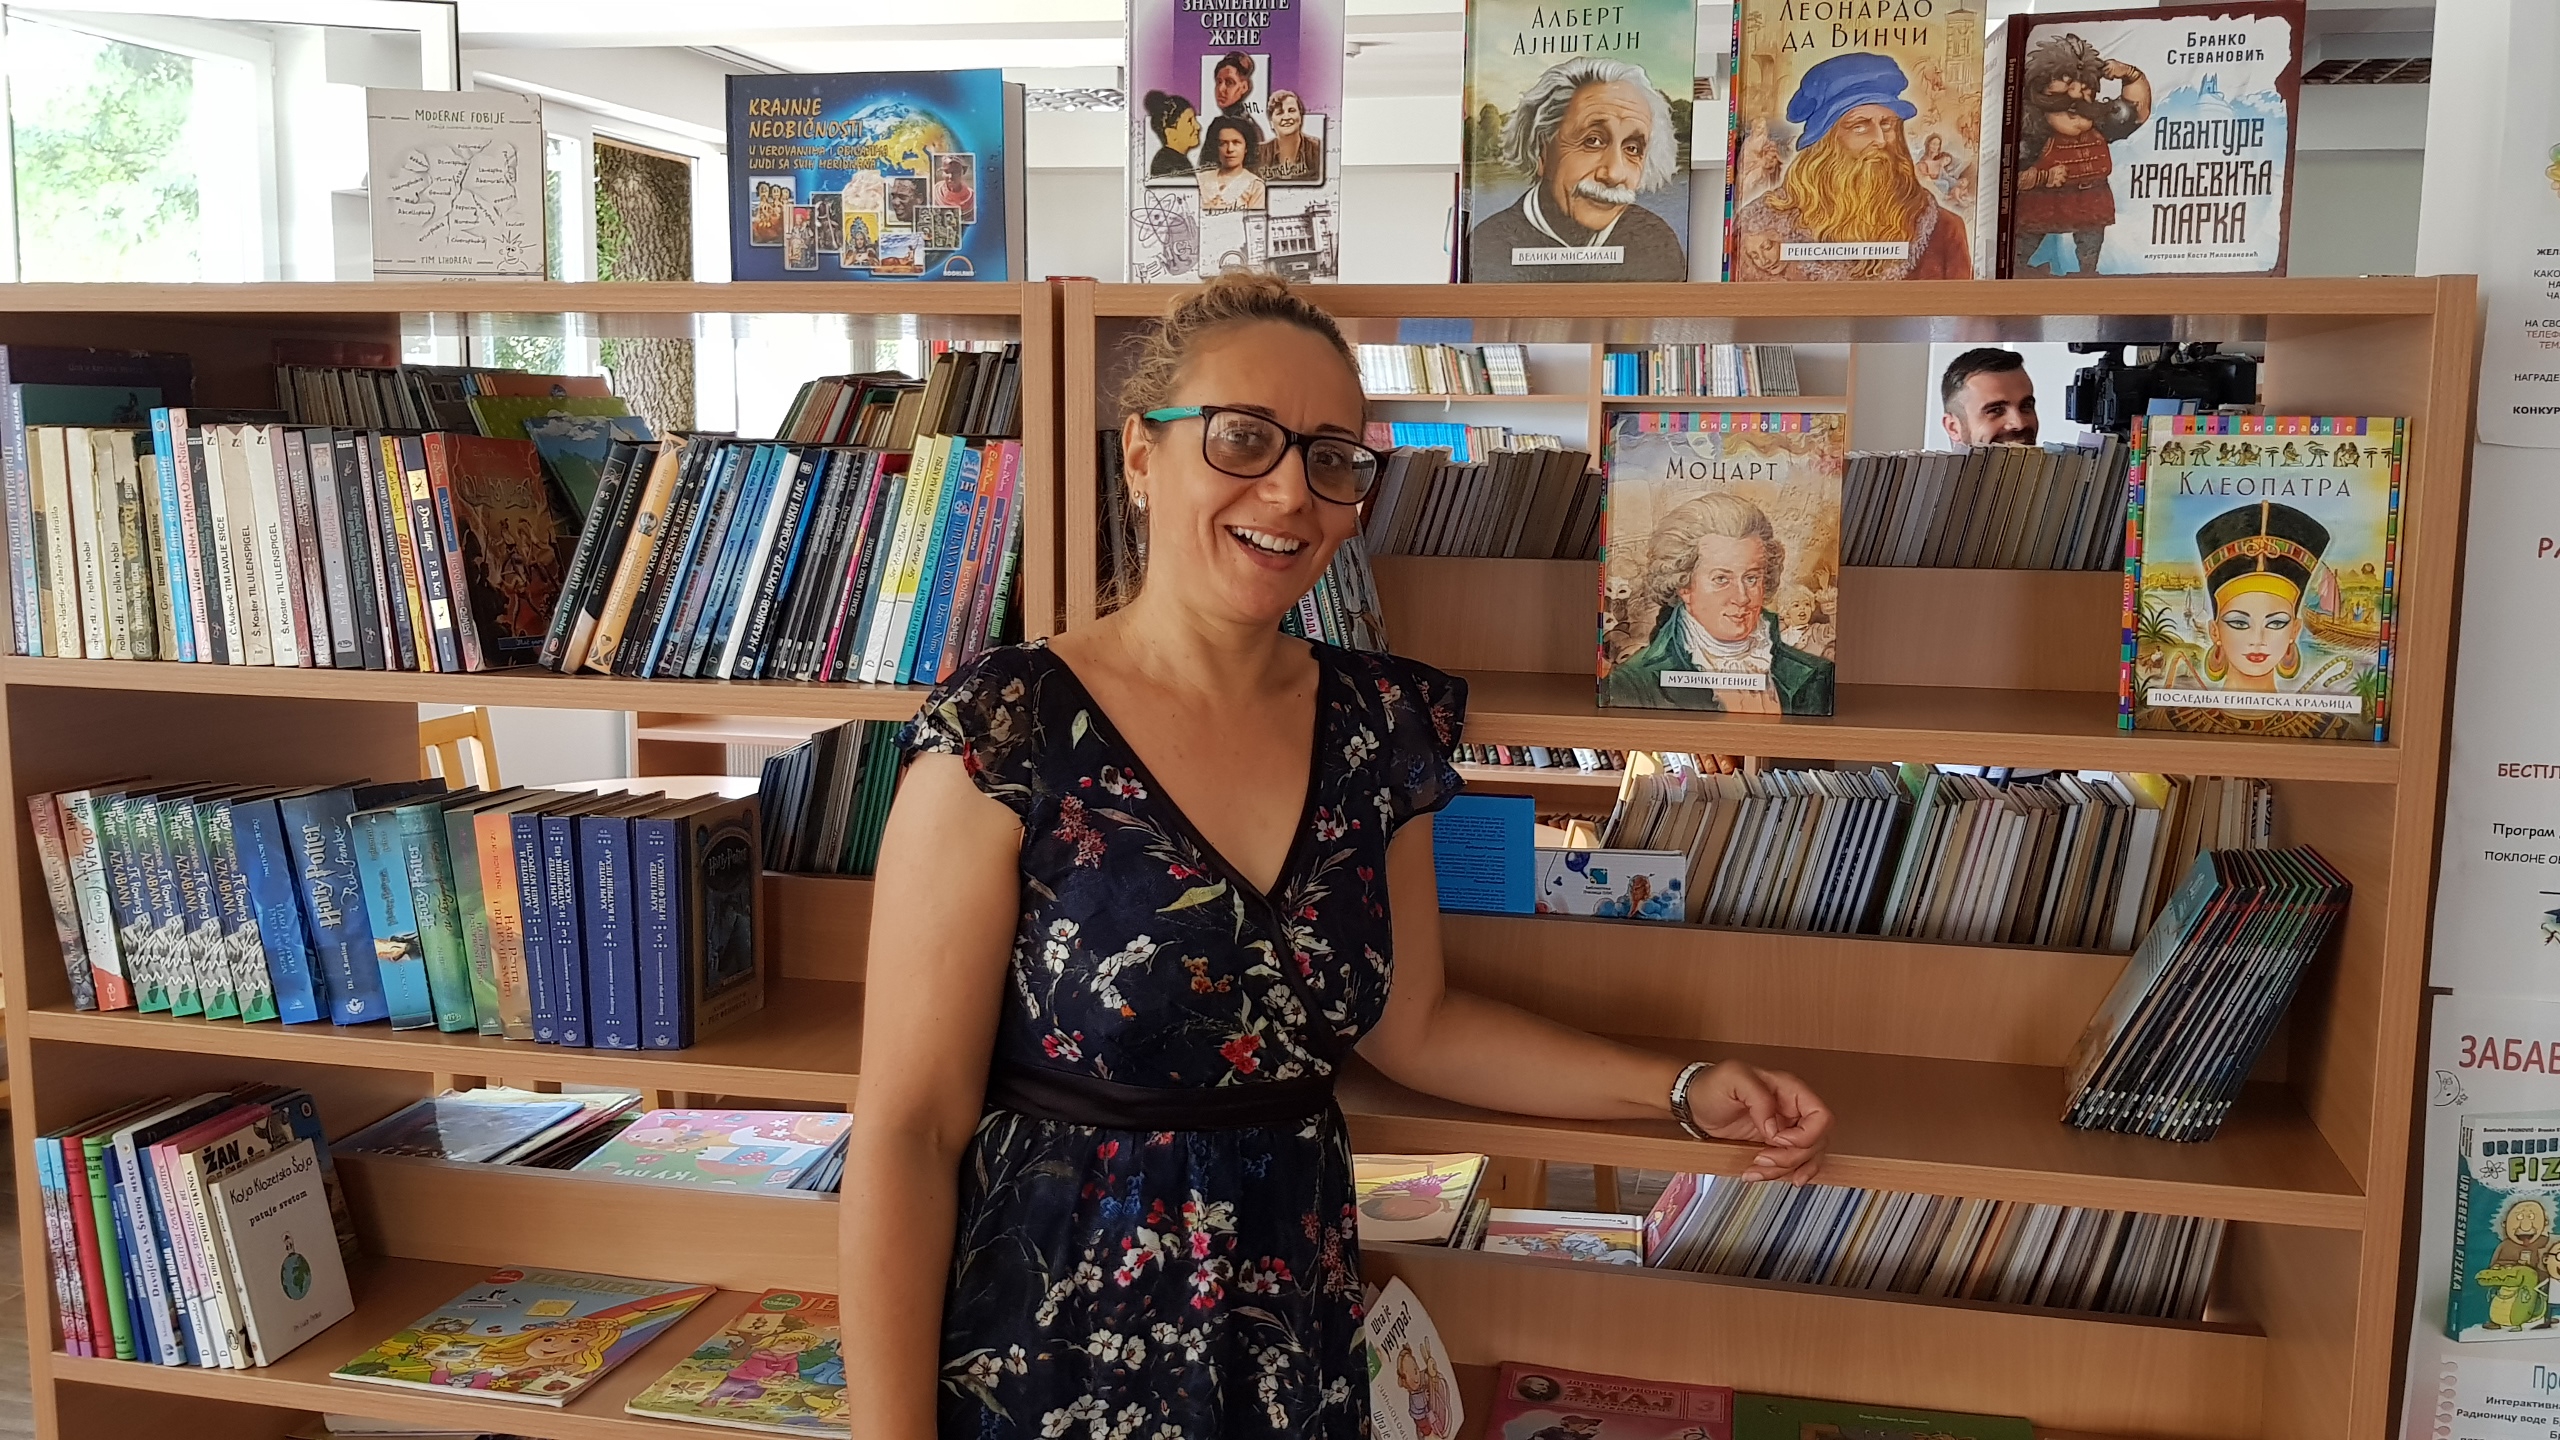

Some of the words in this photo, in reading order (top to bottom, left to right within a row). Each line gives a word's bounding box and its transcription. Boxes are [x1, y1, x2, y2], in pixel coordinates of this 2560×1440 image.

[1182, 0, 1290, 11] ЗНАМЕНИТЕ
[1531, 5, 1625, 30] АЛБЕРТ
[1779, 0, 1933, 22] ЛЕОНАРДО
[1200, 11, 1270, 29] СРПСКЕ
[1208, 29, 1261, 46] ЖЕНЕ
[1512, 31, 1641, 56] АЈНШТАЈН
[1831, 22, 1928, 48] ВИНЧИ
[2186, 31, 2247, 48] БРАНКО
[2166, 48, 2265, 65] СТЕВАНОВИЋ
[415, 109, 466, 123] MODERNE
[470, 111, 506, 124] FOBIJE
[749, 97, 822, 116] KRAJNJE
[749, 116, 863, 139] NEOBIČNOSTI
[749, 145, 756, 157] U
[758, 144, 826, 157] VEROVANJIMA
[749, 157, 776, 170] LJUDI
[778, 157, 790, 170] SA
[793, 157, 814, 171] SVIH
[421, 256, 435, 264] TIM
[438, 256, 473, 265] LIHOREAU
[1518, 251, 1558, 262] ВЕЛИКИ
[1560, 250, 1618, 262] МИСЛИЛАЦ
[1787, 246, 1859, 257] РЕНЕСАНСНИ
[1861, 245, 1901, 256] ГЕНИЈЕ
[2524, 319, 2538, 328] НА
[2514, 373, 2560, 382] НАГРАДЕ
[1650, 421, 1688, 429] мини
[1699, 420, 1799, 433] биографије
[2184, 424, 2228, 433] мини
[2242, 422, 2354, 435] биографије
[932, 455, 944, 475] NEBU
[929, 476, 938, 487] NA
[2179, 470, 2352, 498] КЛЕОПАТРА
[922, 487, 935, 515] OSTRVA
[216, 516, 227, 541] SRCE
[419, 530, 435, 552] lampe
[658, 525, 680, 576] NEPOZNATE
[675, 497, 689, 523] PLIME
[109, 541, 120, 562] hobit
[219, 544, 230, 574] LAVLJE
[568, 549, 591, 590] ЦИРКУС
[583, 504, 605, 547] НАКАЗА
[428, 560, 436, 568] F.
[430, 569, 438, 579] B.
[653, 564, 678, 624] PROKLETSTVO
[674, 531, 688, 562] CRNOG
[684, 502, 698, 530] BISERA
[111, 571, 123, 593] tolkin
[222, 575, 232, 591] TIM
[432, 581, 441, 596] Ker
[848, 589, 861, 617] ZEMLJA
[855, 568, 866, 588] KROZ
[861, 537, 875, 567] VRIJEME
[907, 623, 919, 647] ИВАН
[913, 588, 927, 622] ИВАЊИ
[924, 537, 940, 571] АЈКУЛА
[933, 524, 943, 536] СА
[117, 633, 128, 650] nolit
[1668, 674, 1719, 685] МУЗИЧКИ
[1721, 676, 1758, 687] ГЕНИЈЕ
[2153, 691, 2220, 705] ПОСЛЕДЊА
[2223, 695, 2291, 707] ЕГИПАТСКА
[2295, 697, 2354, 710] КРАЉИЦА
[101, 810, 117, 836] Potter
[133, 813, 149, 839] Potter
[168, 814, 185, 841] Potter
[205, 817, 223, 844] Potter
[2492, 822, 2556, 840] Програм
[295, 819, 336, 880] Potter
[554, 845, 561, 856] ИЗ
[604, 848, 612, 876] ПЕХАР
[404, 841, 429, 889] Potter
[520, 857, 529, 884] ПОТЕР
[526, 842, 537, 884] МУДРОСТИ
[548, 857, 556, 883] ПОТЕР
[108, 848, 132, 908] AZKABANA
[140, 851, 163, 910] AZKABANA
[175, 852, 198, 912] AZKABANA
[213, 855, 236, 915] AZKABANA
[335, 869, 358, 905] Red
[555, 857, 565, 910] ЗАТВОРЕНИК
[562, 859, 572, 904] АСКАБАНА
[309, 876, 344, 930] Harry
[523, 885, 531, 907] ХАРИ
[530, 885, 540, 914] КАМЕН
[606, 877, 614, 913] ВАТРЕНИ
[415, 887, 437, 930] Harry
[532, 925, 538, 934] 1
[561, 928, 567, 936] 3
[606, 931, 612, 939] 4
[202, 1139, 240, 1175] ŽAN
[125, 1159, 138, 1192] MESECA
[253, 1167, 291, 1193] Klozetska
[249, 1206, 277, 1227] putuje
[279, 1190, 308, 1210] svetom
[2455, 1174, 2469, 1244] URNEBESNA
[141, 1234, 149, 1244] SA
[163, 1247, 176, 1275] КОАЛА
[2452, 1249, 2464, 1290] FIZIKA
[1381, 1300, 1412, 1362] унутра?
[1565, 1385, 1675, 1408] ЗМАЈ
[2456, 1408, 2518, 1423] Радионицу
[2520, 1415, 2547, 1425] воде
